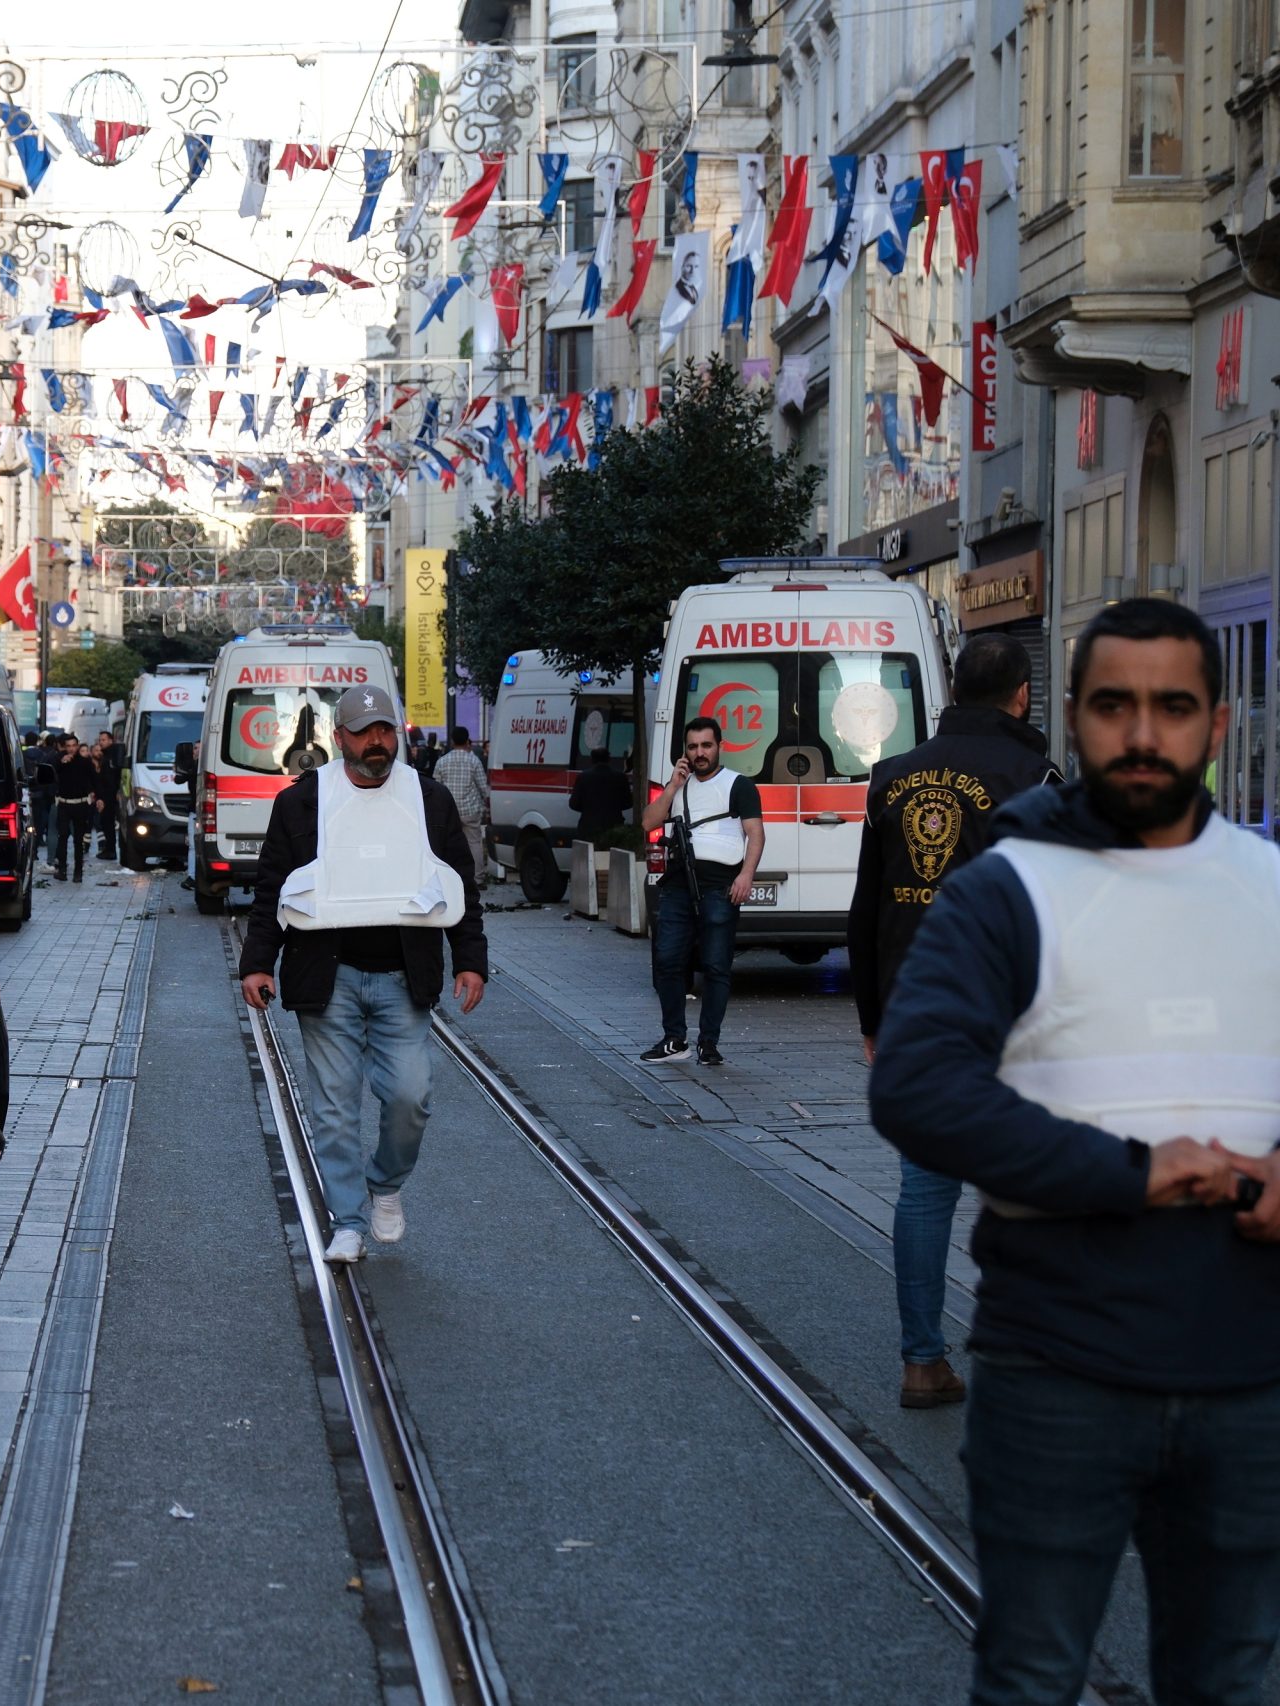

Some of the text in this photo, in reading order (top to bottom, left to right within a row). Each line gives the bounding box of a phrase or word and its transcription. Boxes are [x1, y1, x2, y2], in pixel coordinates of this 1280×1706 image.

[696, 621, 895, 649] AMBULANS
[238, 666, 368, 684] AMBULANS
[167, 692, 189, 700] 112
[510, 716, 568, 735] SAĞLIK BAKANLIĞI
[715, 704, 763, 730] 112
[254, 722, 280, 736] 112
[526, 738, 546, 764] 112
[886, 767, 992, 810] GÜVENLİK BÜRO
[920, 791, 953, 804] POLİS
[893, 884, 940, 905] BEYO
